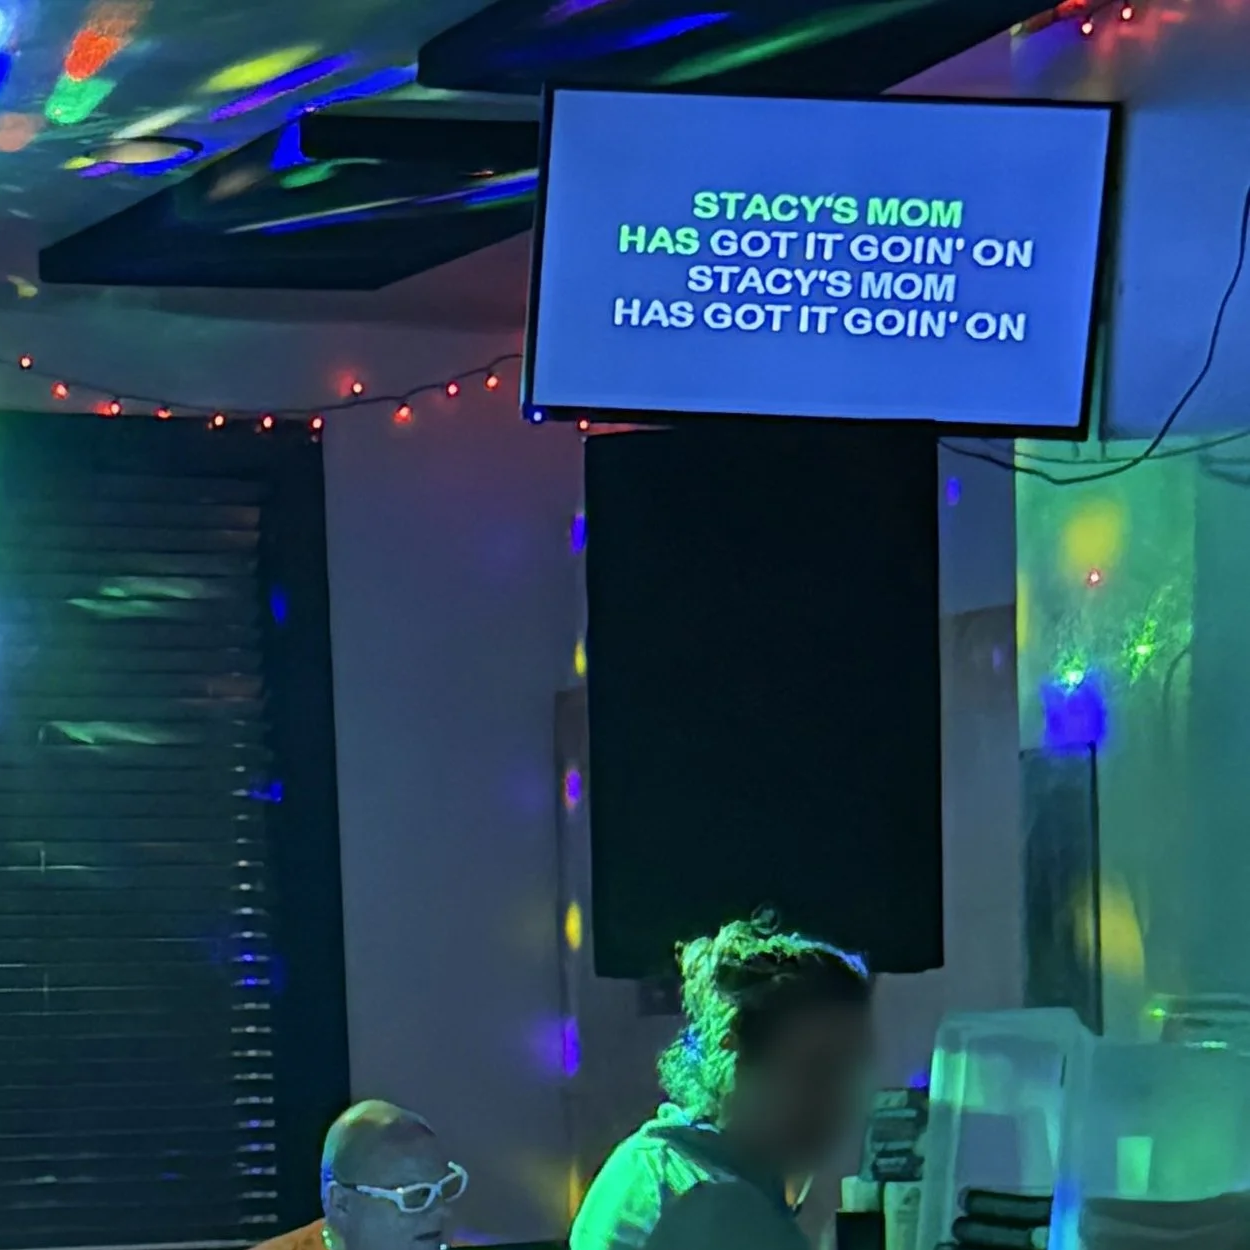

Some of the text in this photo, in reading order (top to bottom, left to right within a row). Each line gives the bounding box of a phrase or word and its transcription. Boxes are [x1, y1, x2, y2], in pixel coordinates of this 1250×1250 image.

[692, 190, 964, 229] STACY'S MOM
[618, 223, 1034, 268] HAS GOT IT GOIN' ON
[687, 264, 956, 303] STACY'S MOM
[613, 297, 1026, 342] HAS GOT IT GOIN' ON
